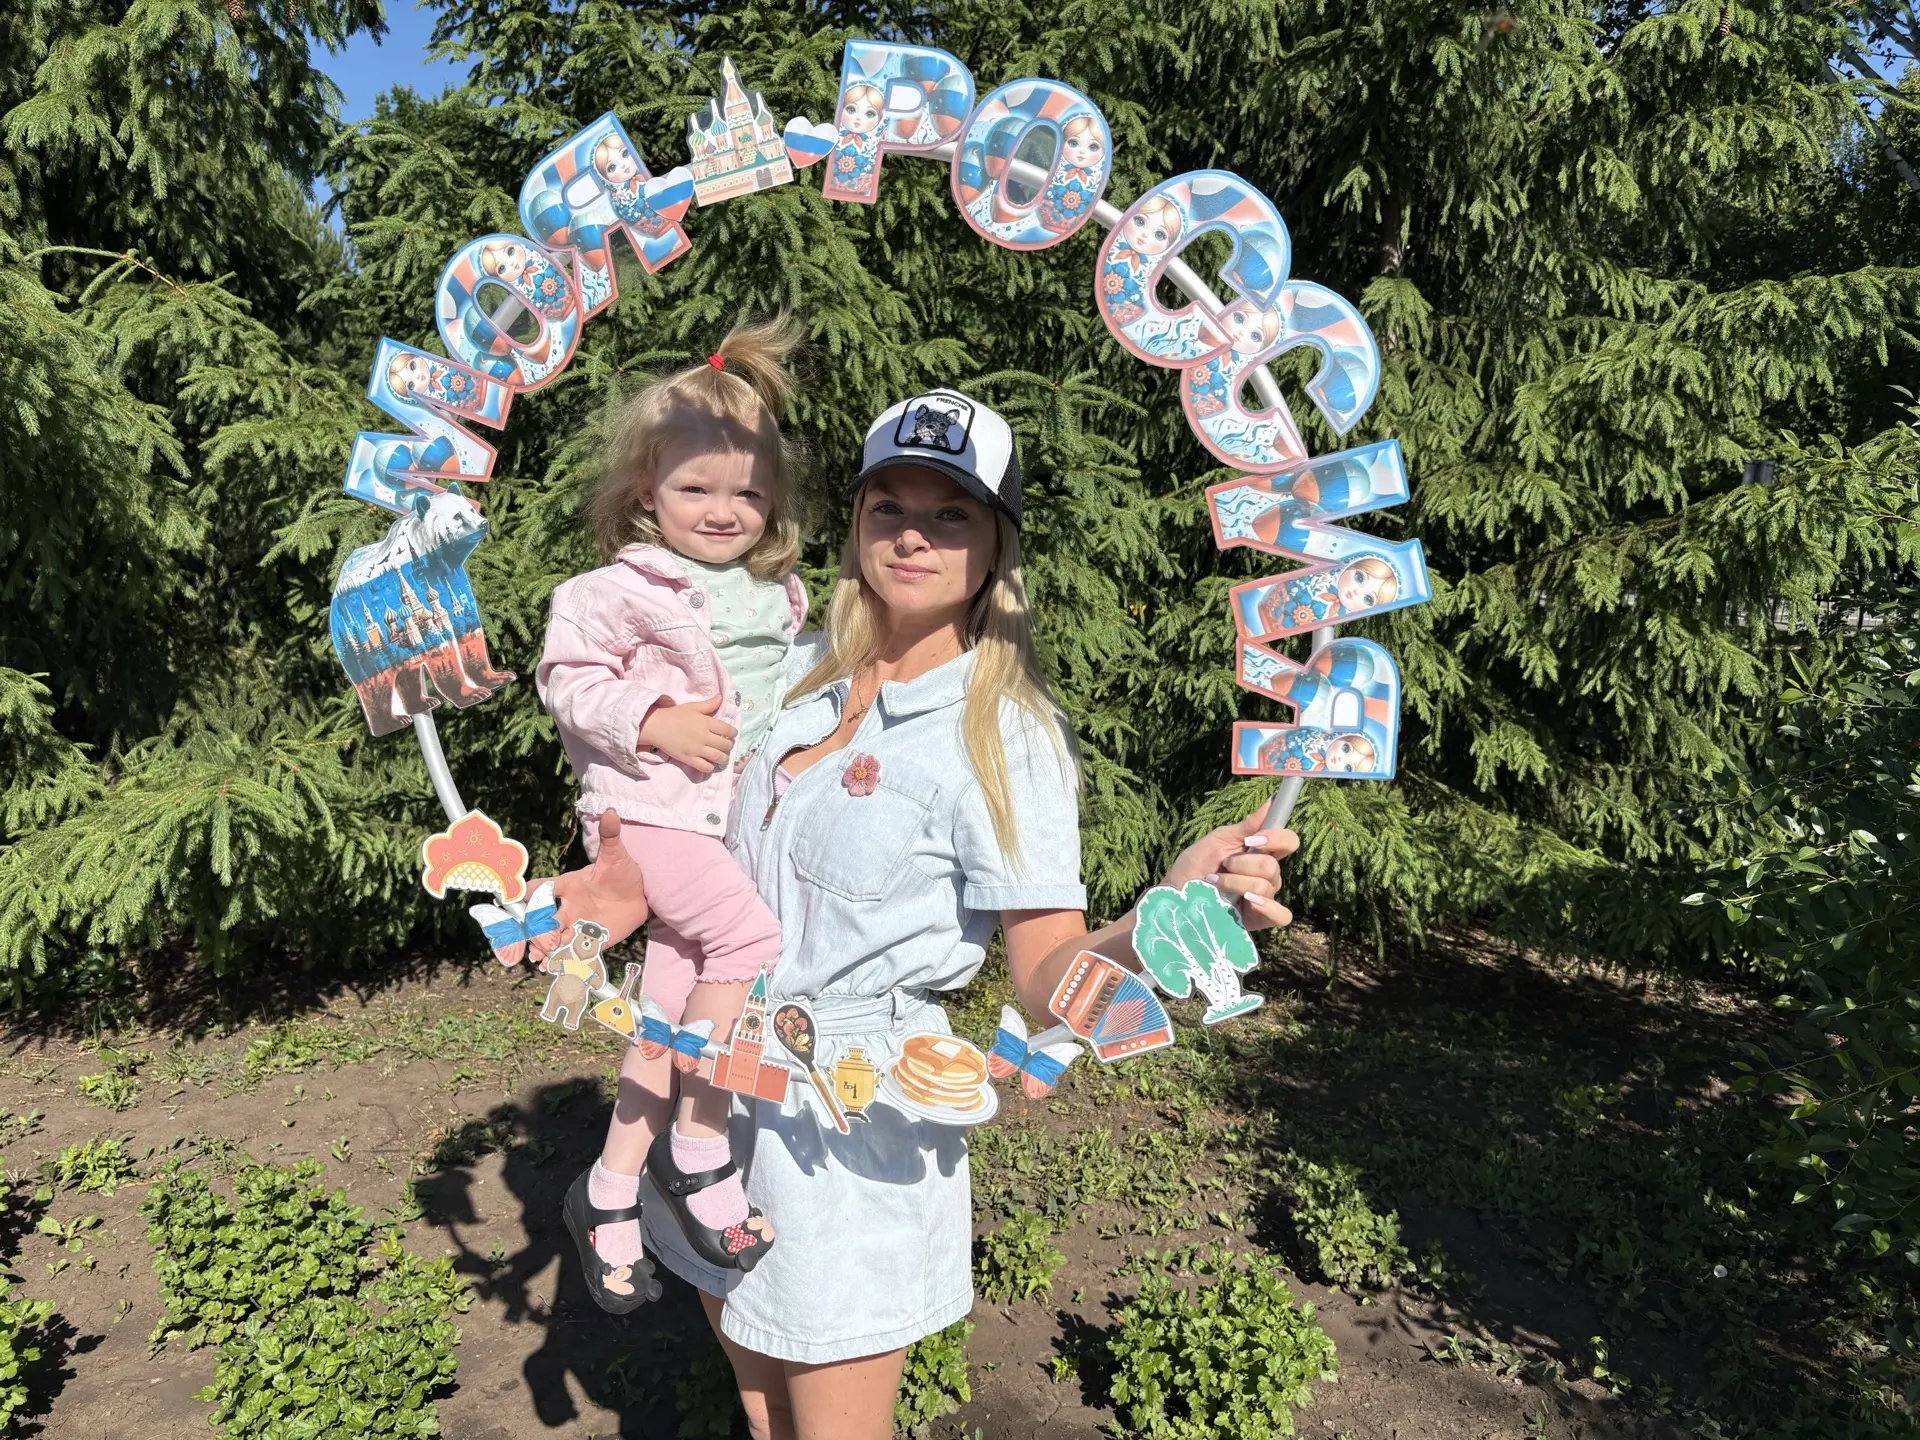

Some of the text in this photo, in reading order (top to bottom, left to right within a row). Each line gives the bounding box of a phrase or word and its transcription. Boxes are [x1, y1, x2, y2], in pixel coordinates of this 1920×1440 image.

[343, 39, 1433, 781] МОЯ РОССИЯ
[936, 397, 969, 411] FRENCHIE
